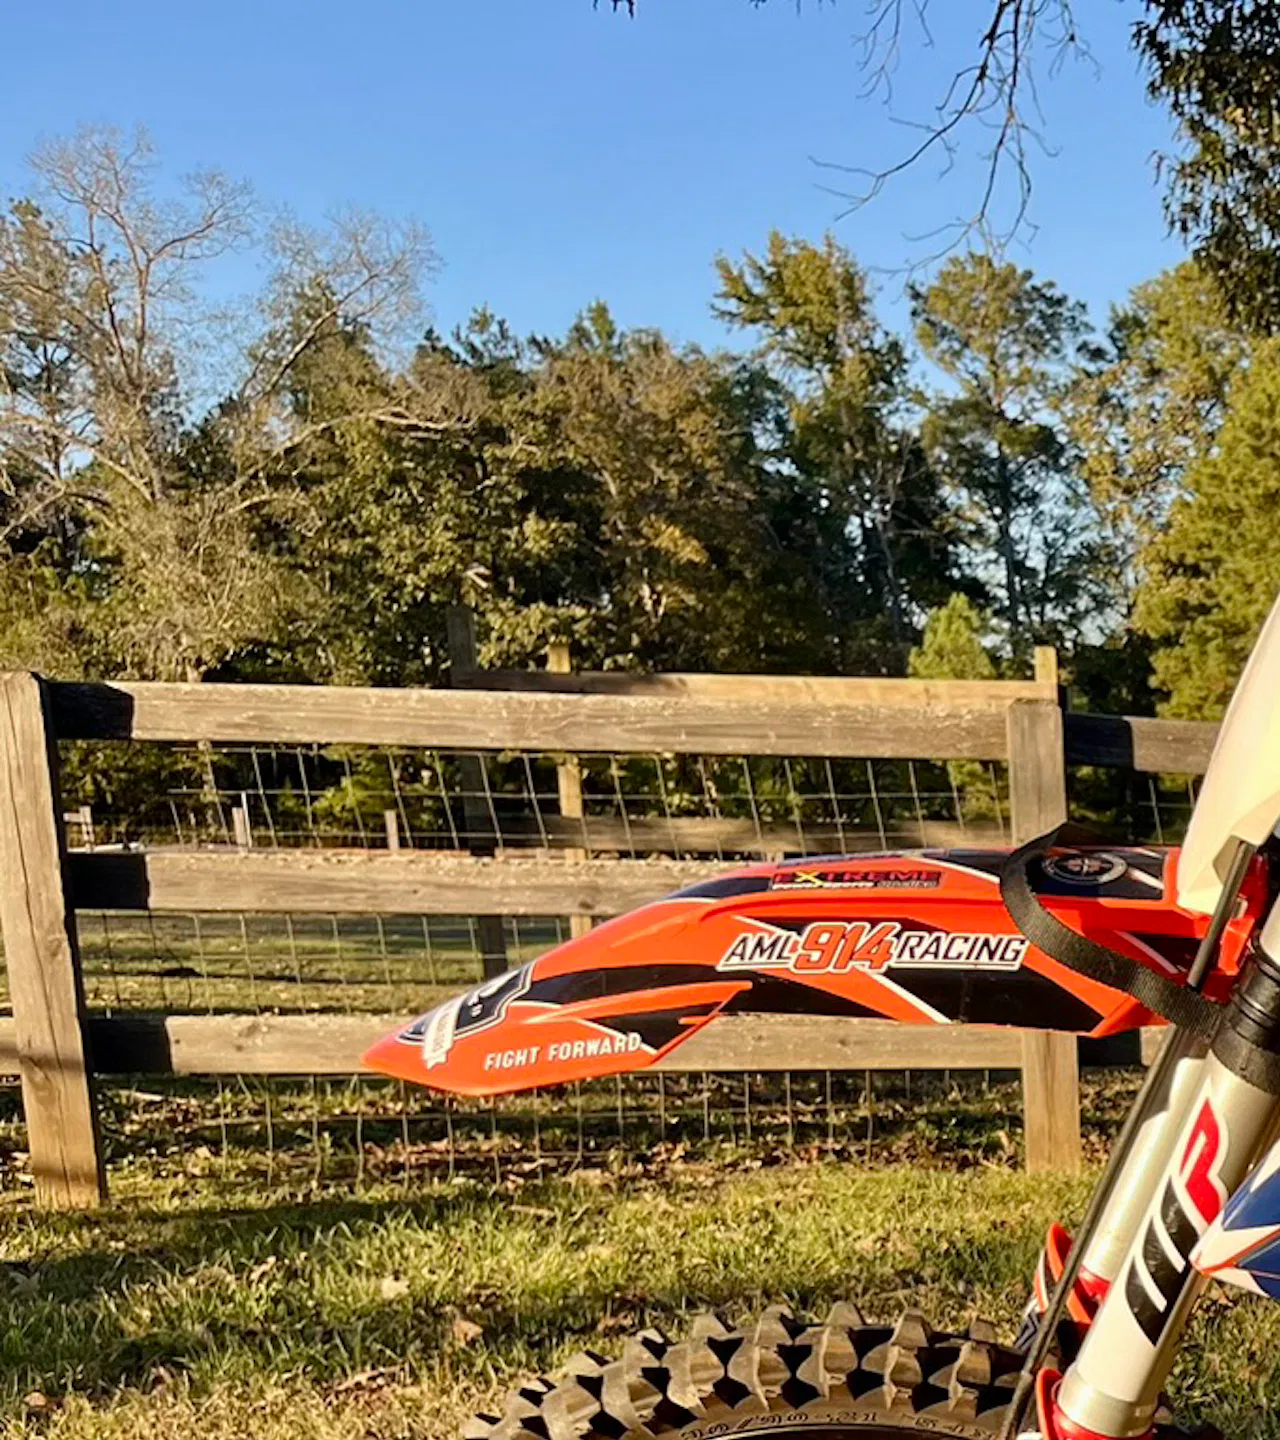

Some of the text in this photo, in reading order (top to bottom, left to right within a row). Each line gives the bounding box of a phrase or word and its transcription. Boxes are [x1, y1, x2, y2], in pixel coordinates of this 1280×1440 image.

[774, 870, 942, 886] EXTREME
[728, 922, 1026, 970] AML 914 RACING
[484, 1032, 642, 1071] FIGHT FORWARD
